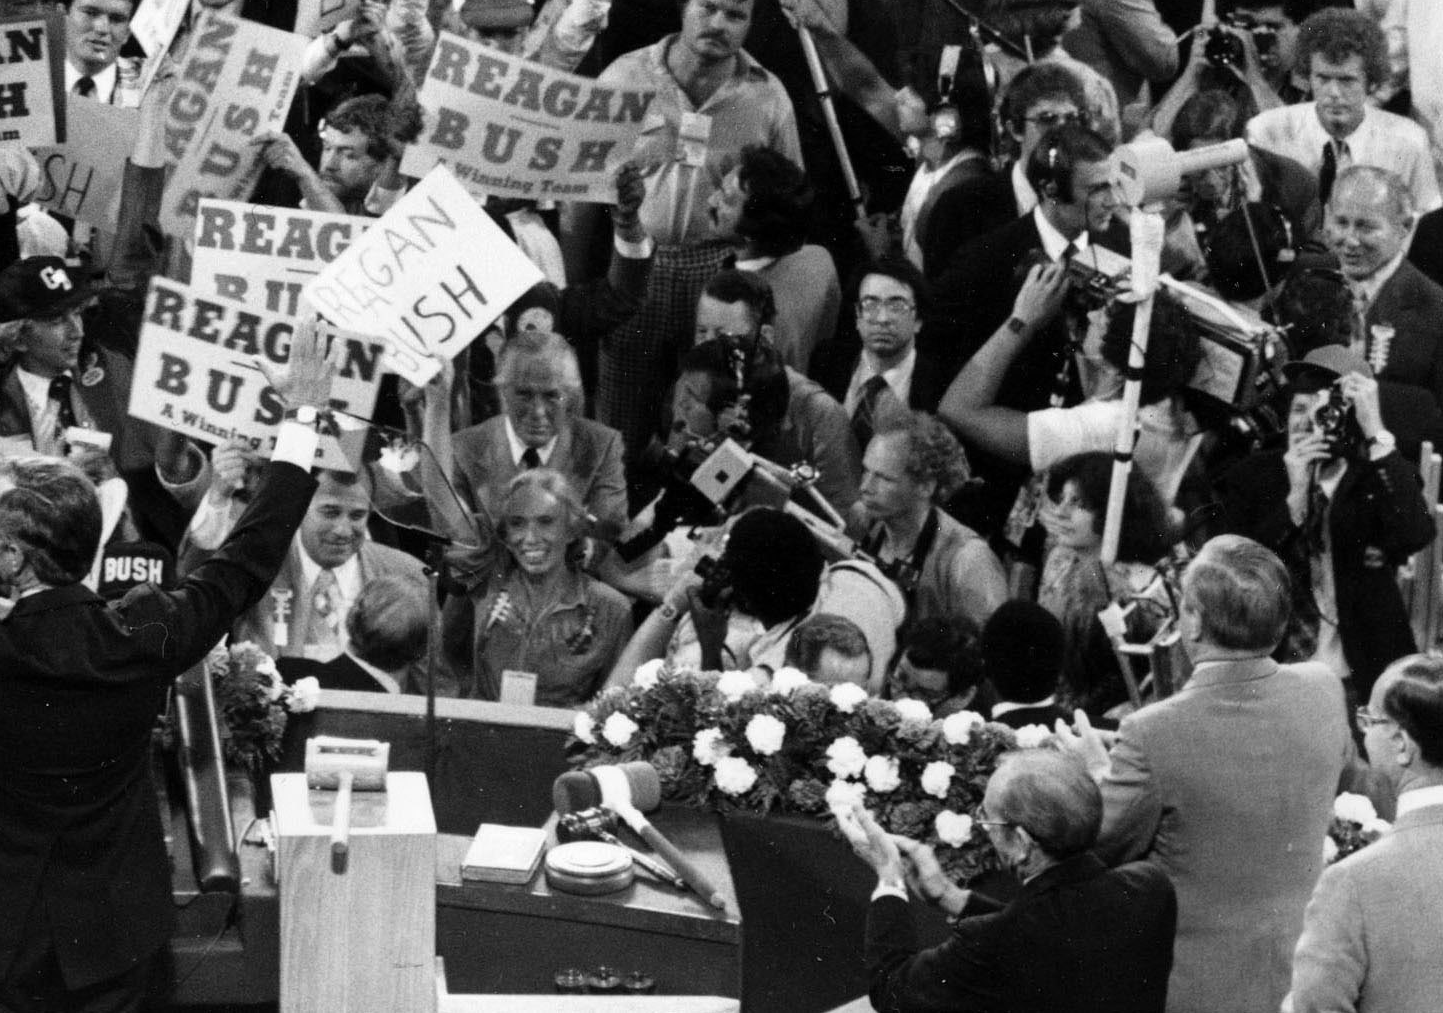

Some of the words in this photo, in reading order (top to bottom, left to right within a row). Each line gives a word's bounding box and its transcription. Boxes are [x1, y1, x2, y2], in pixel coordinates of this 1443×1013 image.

[431, 39, 657, 123] REAGAN
[429, 107, 617, 173] BUSH
[161, 402, 174, 418] A
[181, 408, 263, 451] Winning
[104, 557, 163, 585] BUSH
